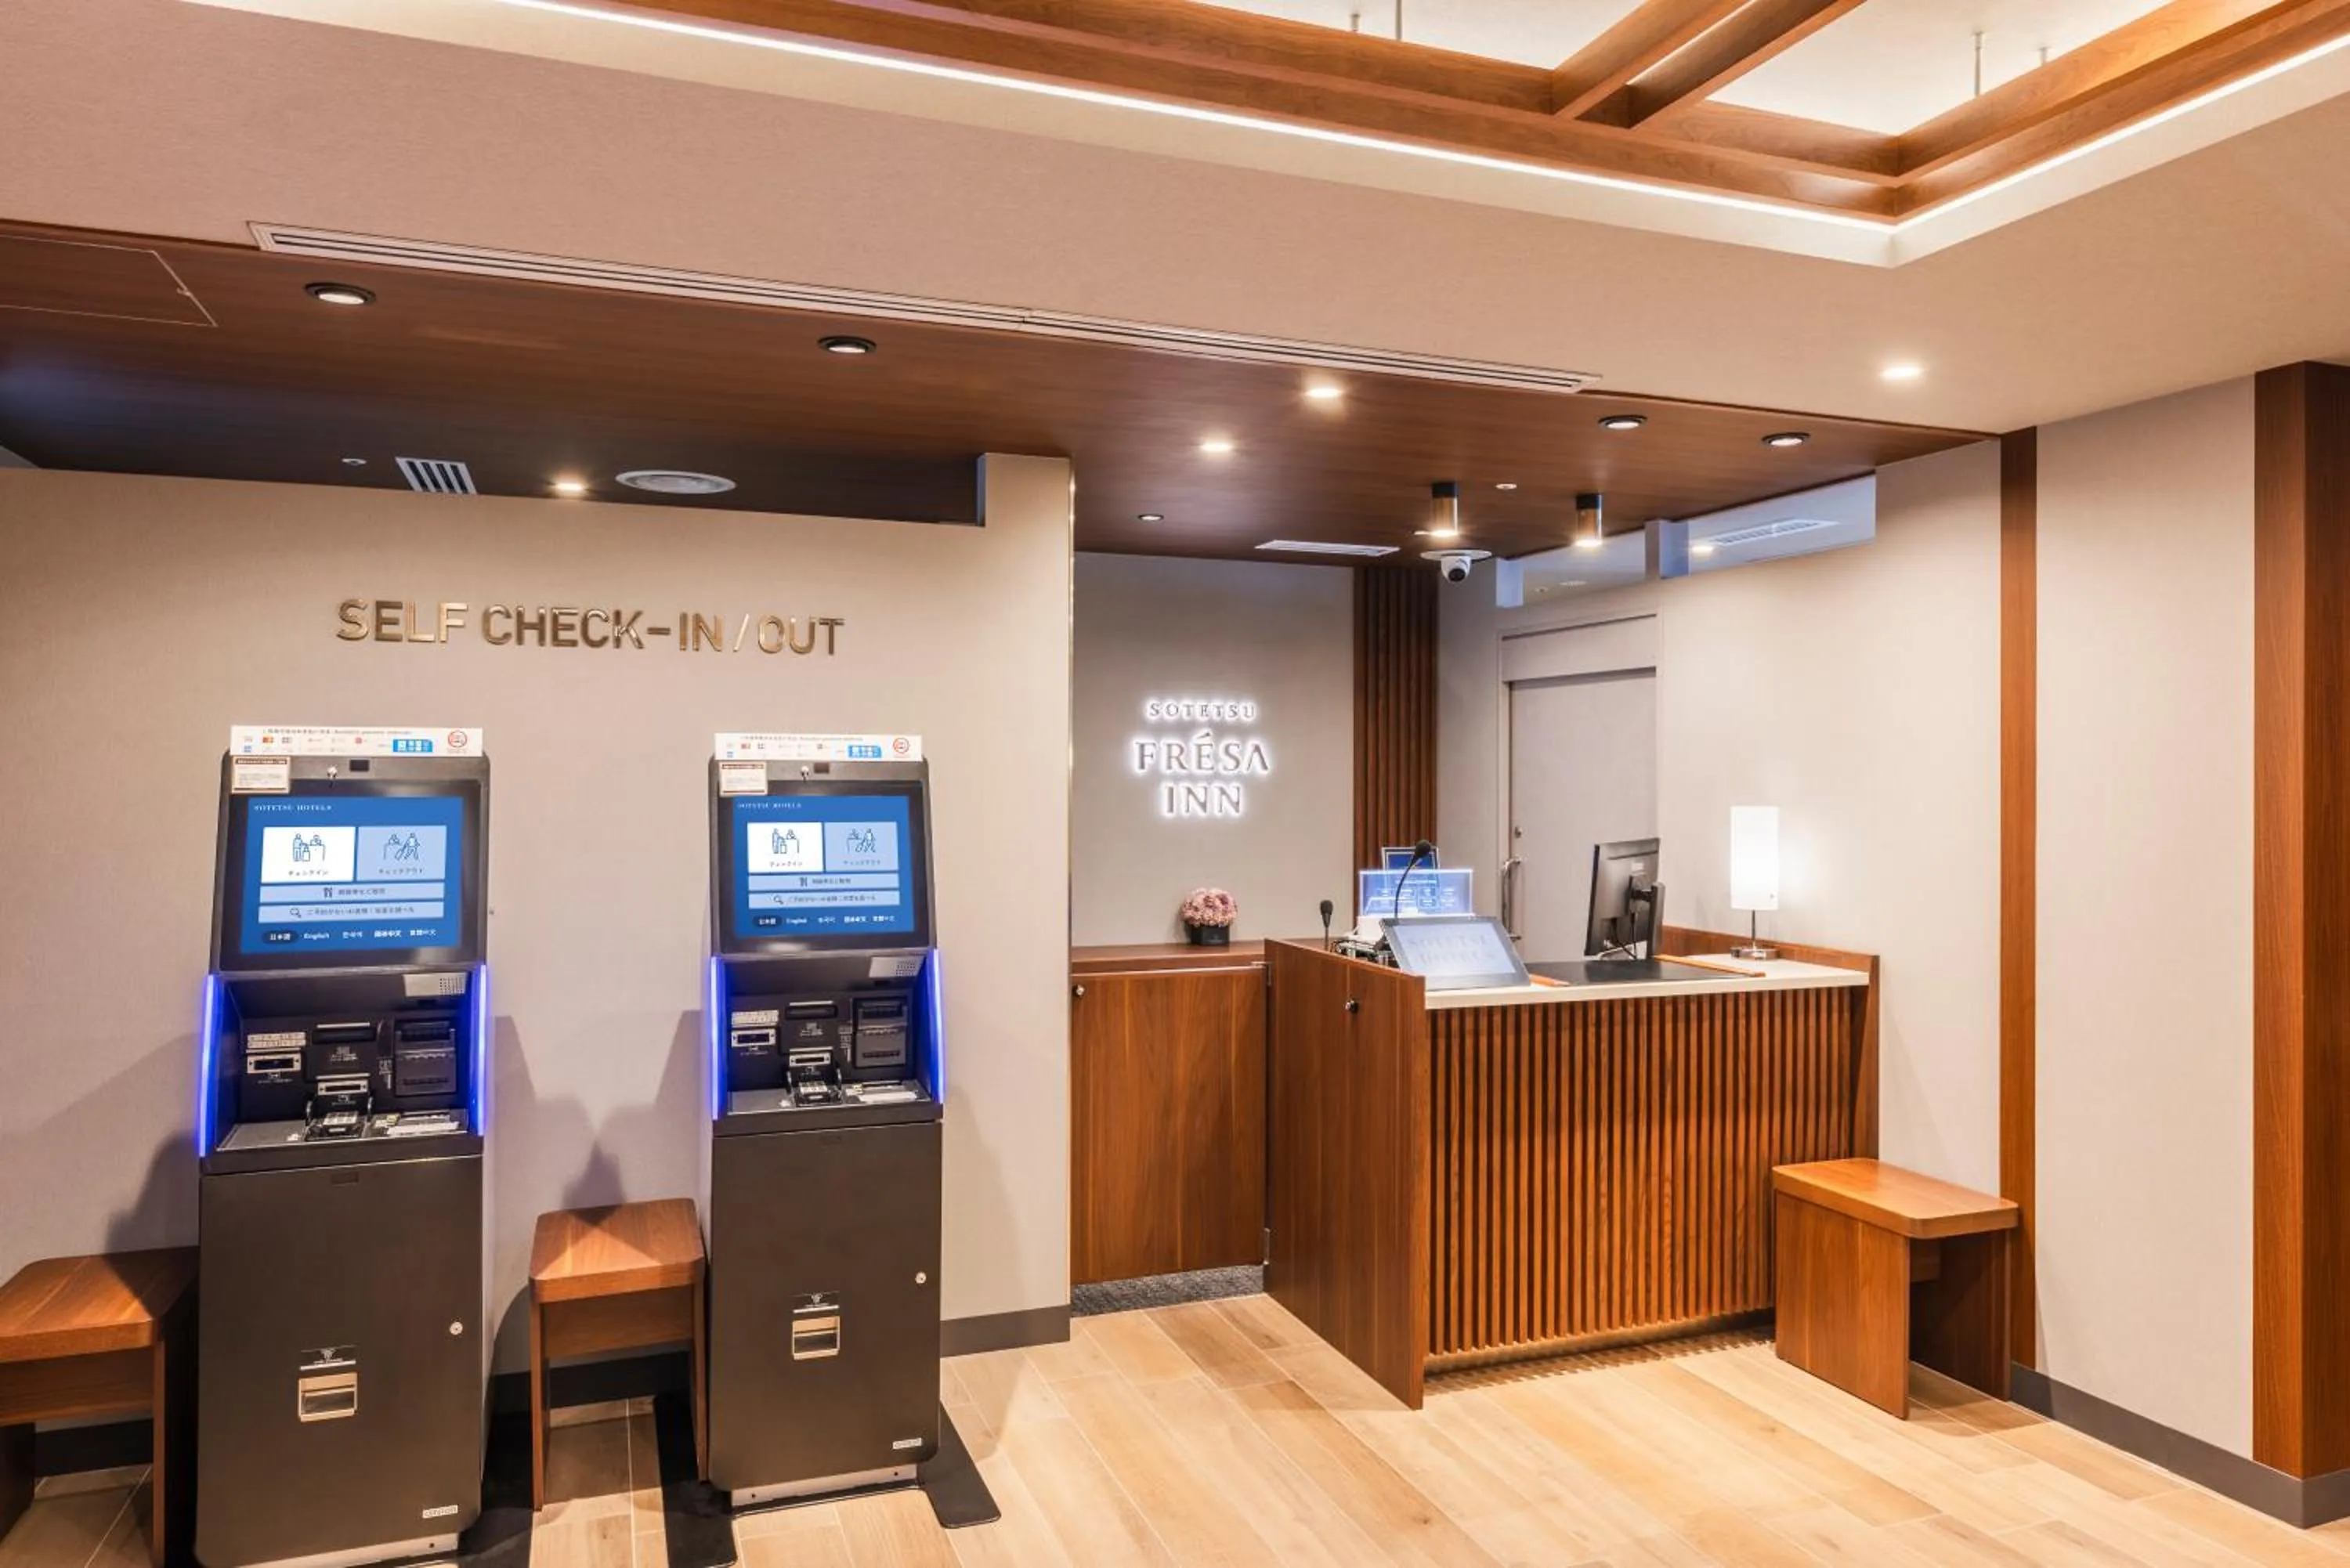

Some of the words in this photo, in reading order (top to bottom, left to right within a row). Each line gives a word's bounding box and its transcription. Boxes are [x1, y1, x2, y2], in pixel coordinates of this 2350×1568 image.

[337, 598, 468, 644] SELF
[1148, 703, 1256, 718] SOTETSU
[1135, 732, 1269, 771] FRÉSA
[1165, 785, 1242, 814] INN
